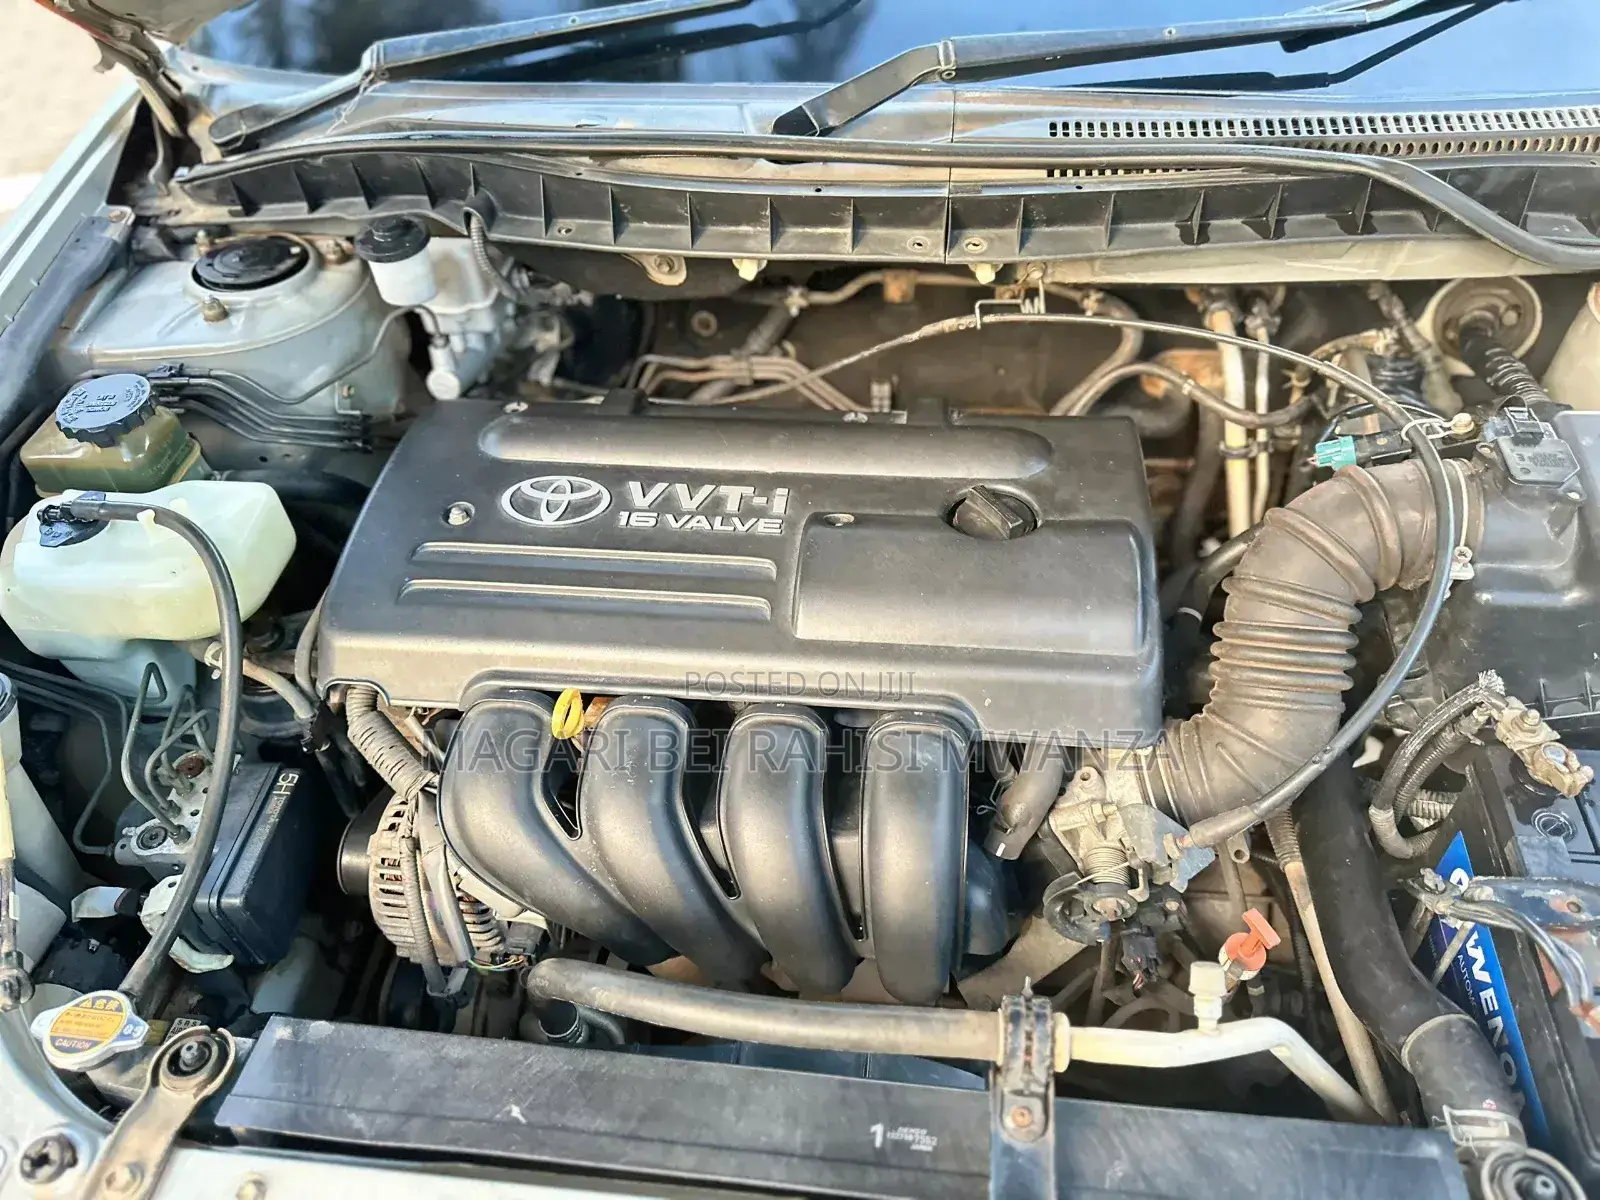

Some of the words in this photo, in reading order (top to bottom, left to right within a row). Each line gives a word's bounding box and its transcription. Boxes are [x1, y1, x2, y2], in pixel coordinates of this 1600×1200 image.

[628, 482, 789, 513] VVT-i
[619, 511, 658, 527] 16
[665, 514, 783, 533] VALVE
[54, 1038, 91, 1049] CAUTION
[870, 1122, 884, 1148] 1
